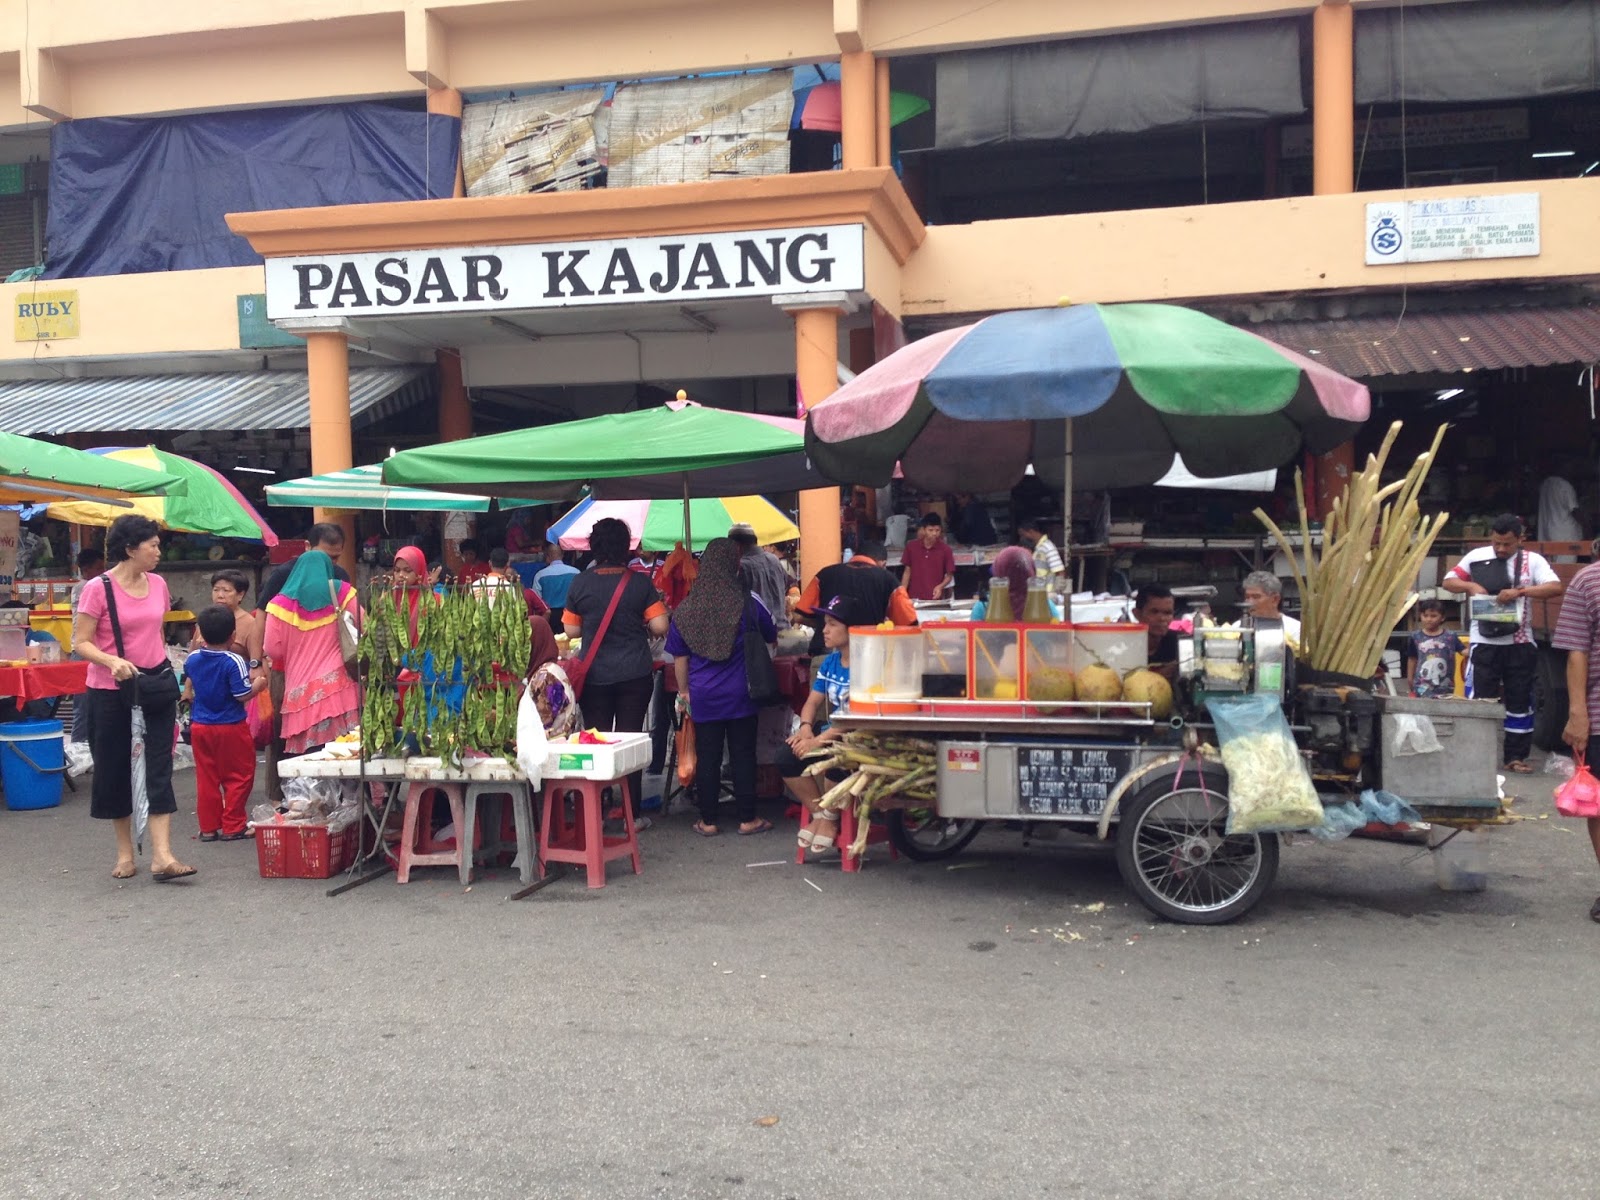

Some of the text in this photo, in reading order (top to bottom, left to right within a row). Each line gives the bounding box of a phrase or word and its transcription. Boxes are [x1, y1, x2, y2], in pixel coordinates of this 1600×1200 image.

[1477, 224, 1509, 233] TEMPAHAN
[1517, 222, 1535, 231] EMAS
[1488, 230, 1504, 238] BATU
[1507, 229, 1535, 237] PERMATA
[1496, 236, 1513, 245] EMAS
[294, 232, 836, 309] PASAR KAJANG
